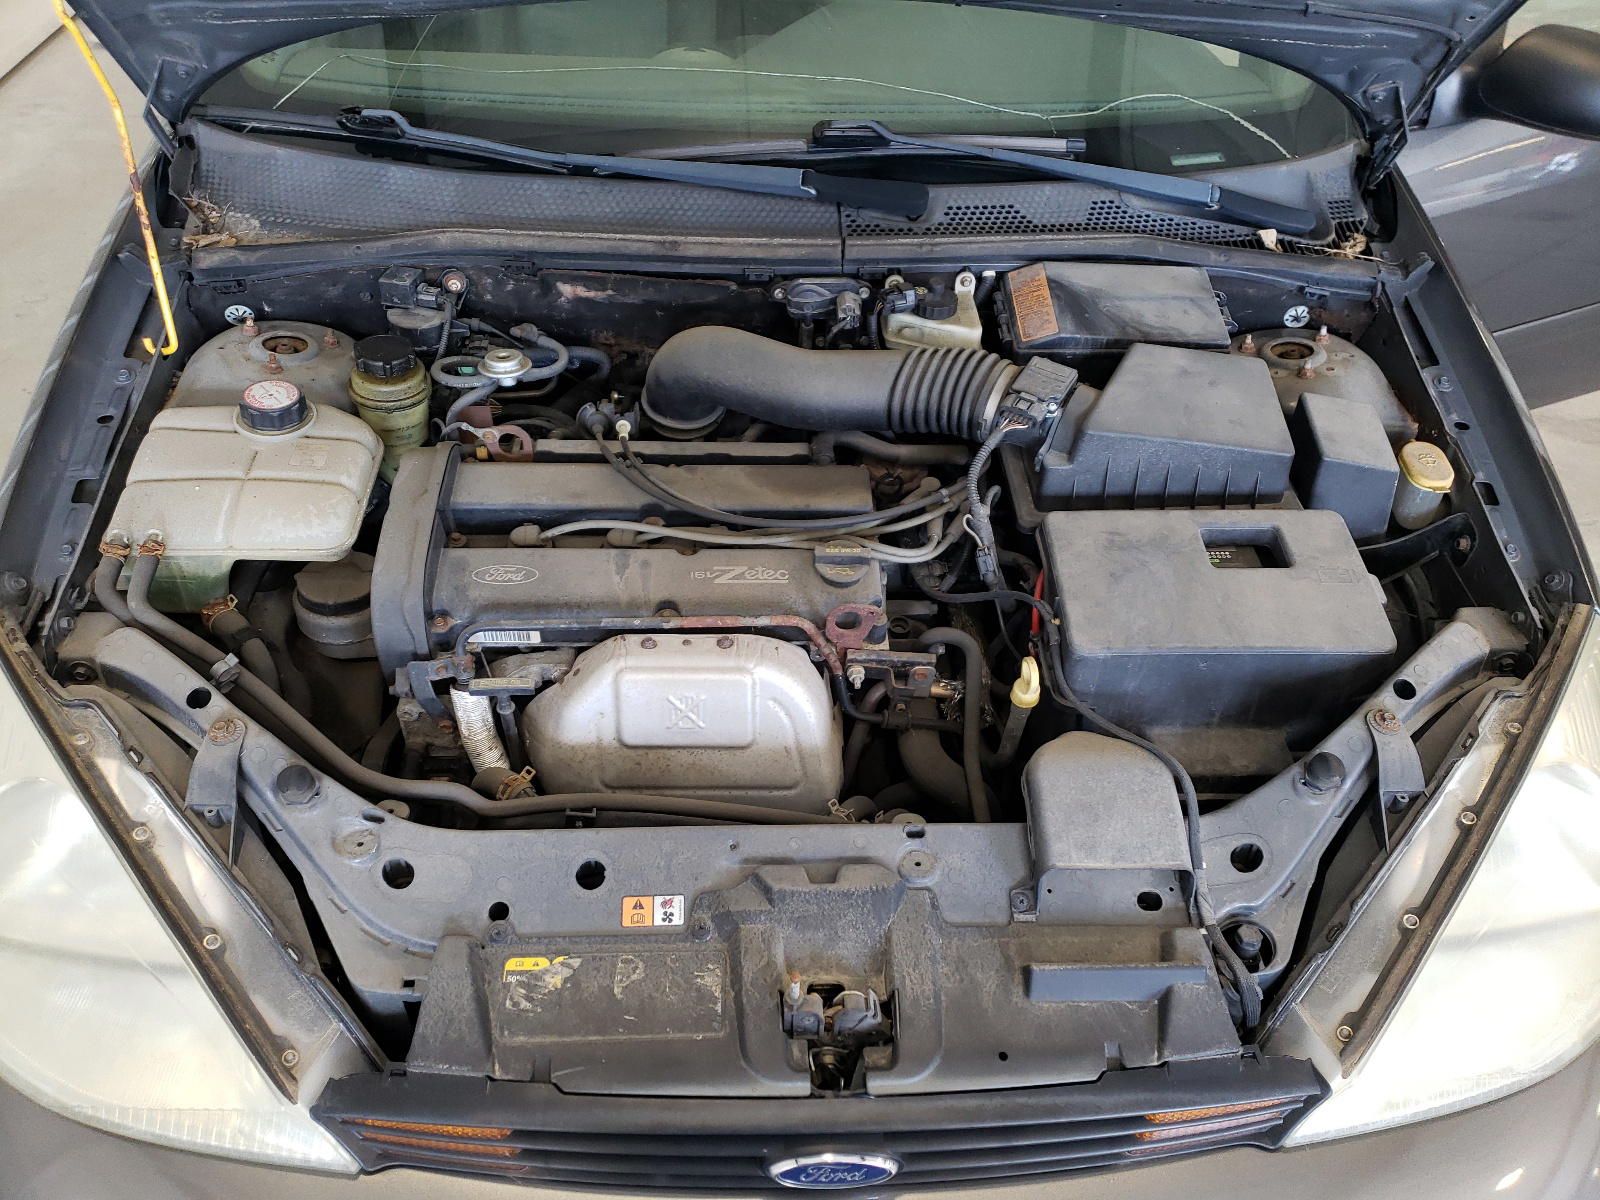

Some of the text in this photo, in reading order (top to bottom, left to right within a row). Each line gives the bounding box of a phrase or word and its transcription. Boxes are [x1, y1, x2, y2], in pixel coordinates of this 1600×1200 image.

[485, 567, 527, 581] Ford
[713, 565, 790, 584] Zetec
[801, 1165, 867, 1182] Ford
